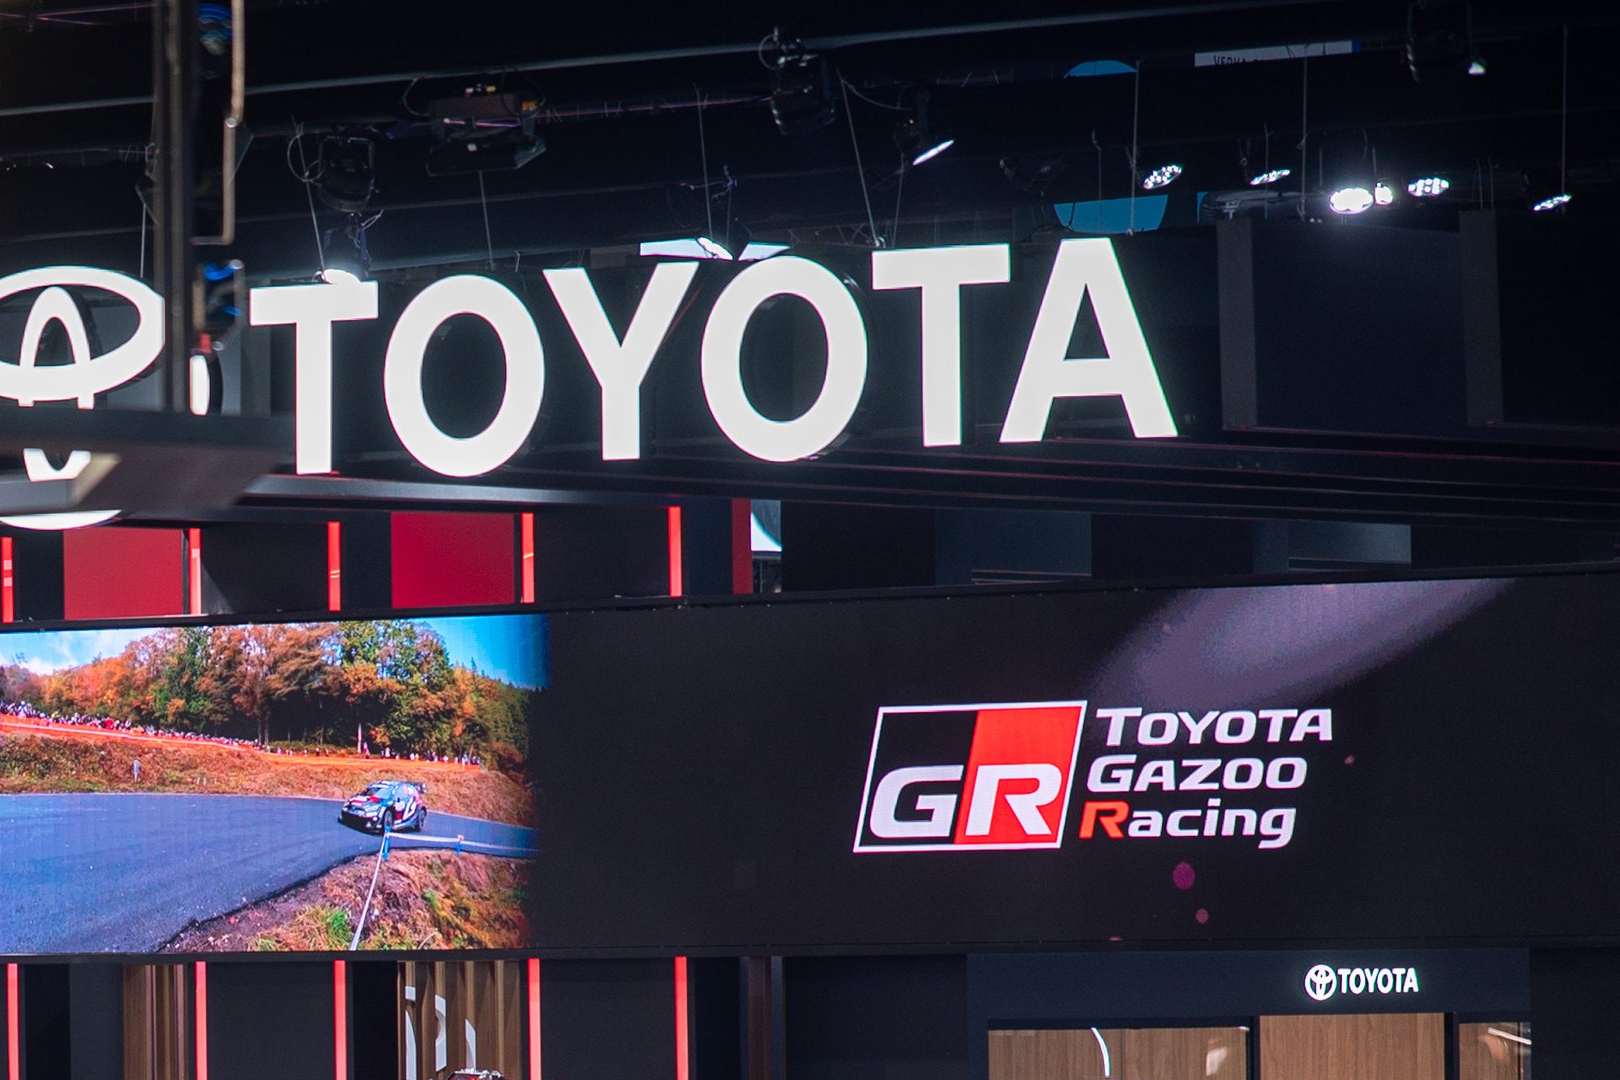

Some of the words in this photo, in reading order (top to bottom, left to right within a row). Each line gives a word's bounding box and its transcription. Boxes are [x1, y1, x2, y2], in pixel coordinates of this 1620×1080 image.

[251, 237, 1180, 478] TOYOTA
[1096, 707, 1332, 746] TOYOTA
[1086, 753, 1307, 793] GAZOO
[869, 763, 1063, 838] GR
[1080, 797, 1296, 849] Racing
[1337, 967, 1419, 994] TOYOTA
